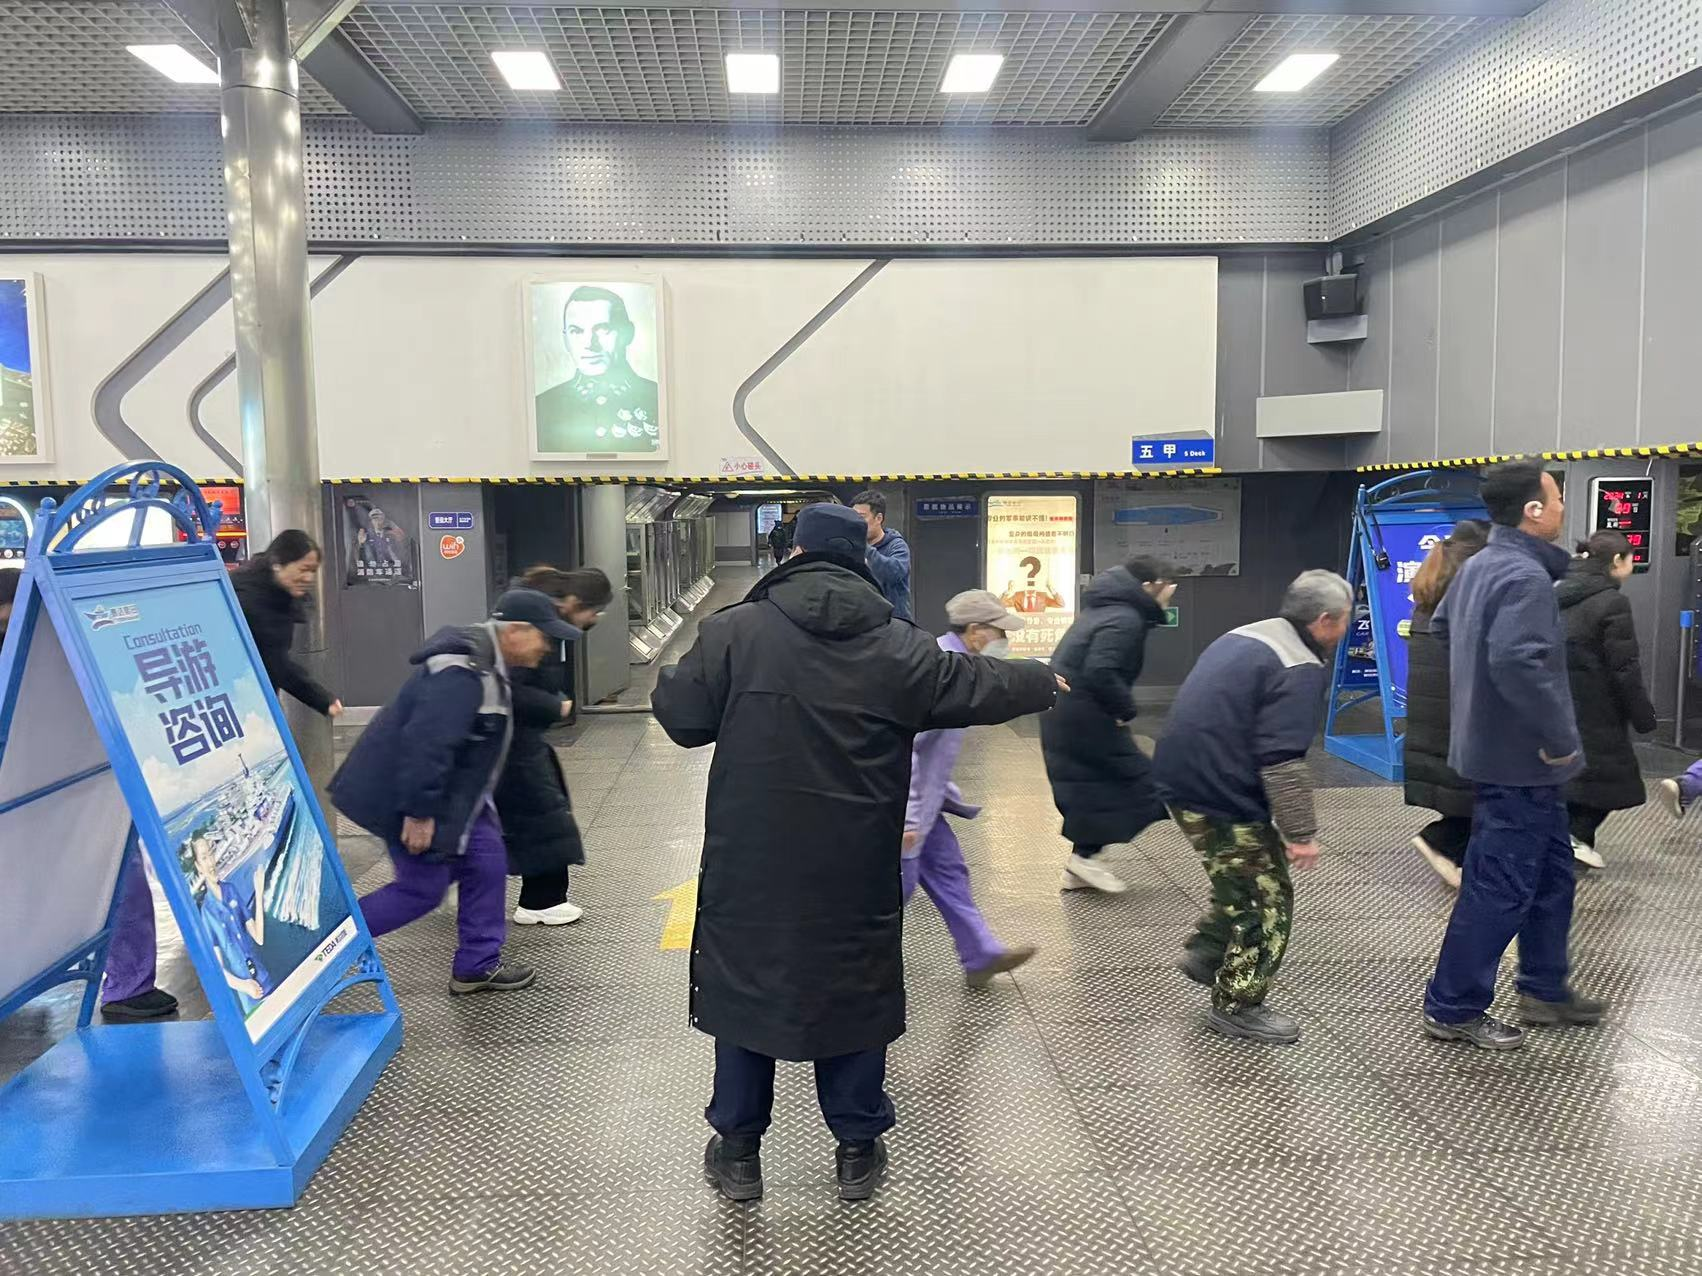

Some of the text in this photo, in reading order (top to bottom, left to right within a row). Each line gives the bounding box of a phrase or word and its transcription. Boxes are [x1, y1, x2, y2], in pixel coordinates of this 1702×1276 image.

[1140, 444, 1176, 459] 五甲
[123, 623, 203, 650] Consultation
[133, 639, 220, 704] 导游
[158, 693, 245, 766] 咨询
